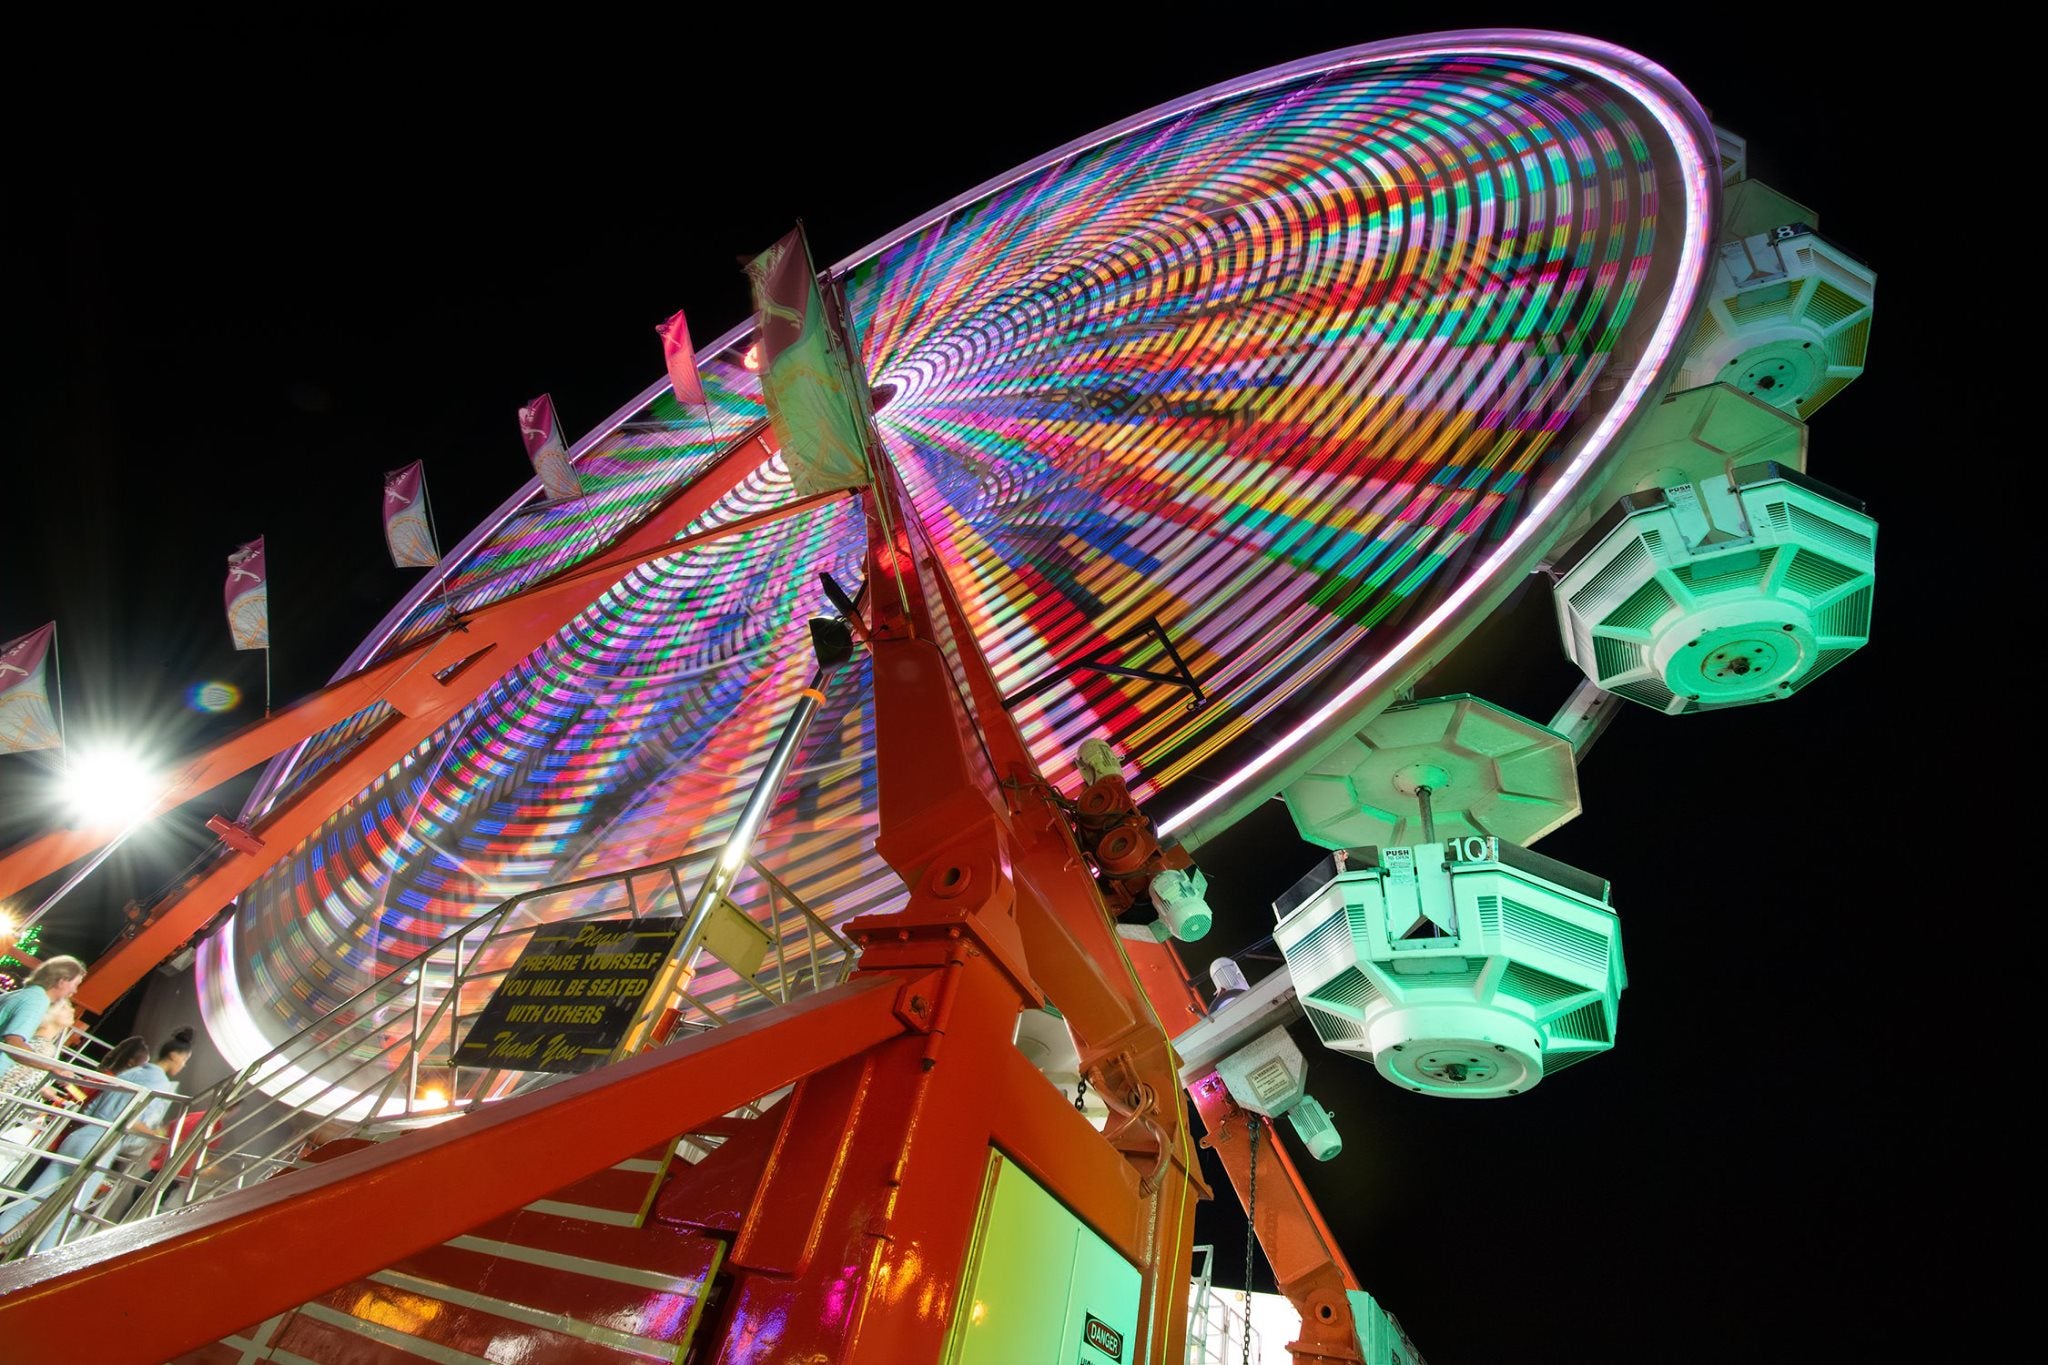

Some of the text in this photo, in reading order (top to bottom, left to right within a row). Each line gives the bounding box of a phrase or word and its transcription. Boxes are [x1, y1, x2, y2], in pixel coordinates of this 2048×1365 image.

[1776, 226, 1794, 239] 8
[1668, 485, 1691, 493] PUSH
[1449, 836, 1488, 862] 10
[570, 925, 629, 948] Please
[520, 952, 662, 972] PREPARE YOURSELF
[501, 978, 650, 997] YOU WILL BE SEATED
[505, 1005, 606, 1024] WITH OTHERS
[488, 1031, 582, 1068] Thank You
[1090, 1323, 1118, 1354] DANGER
